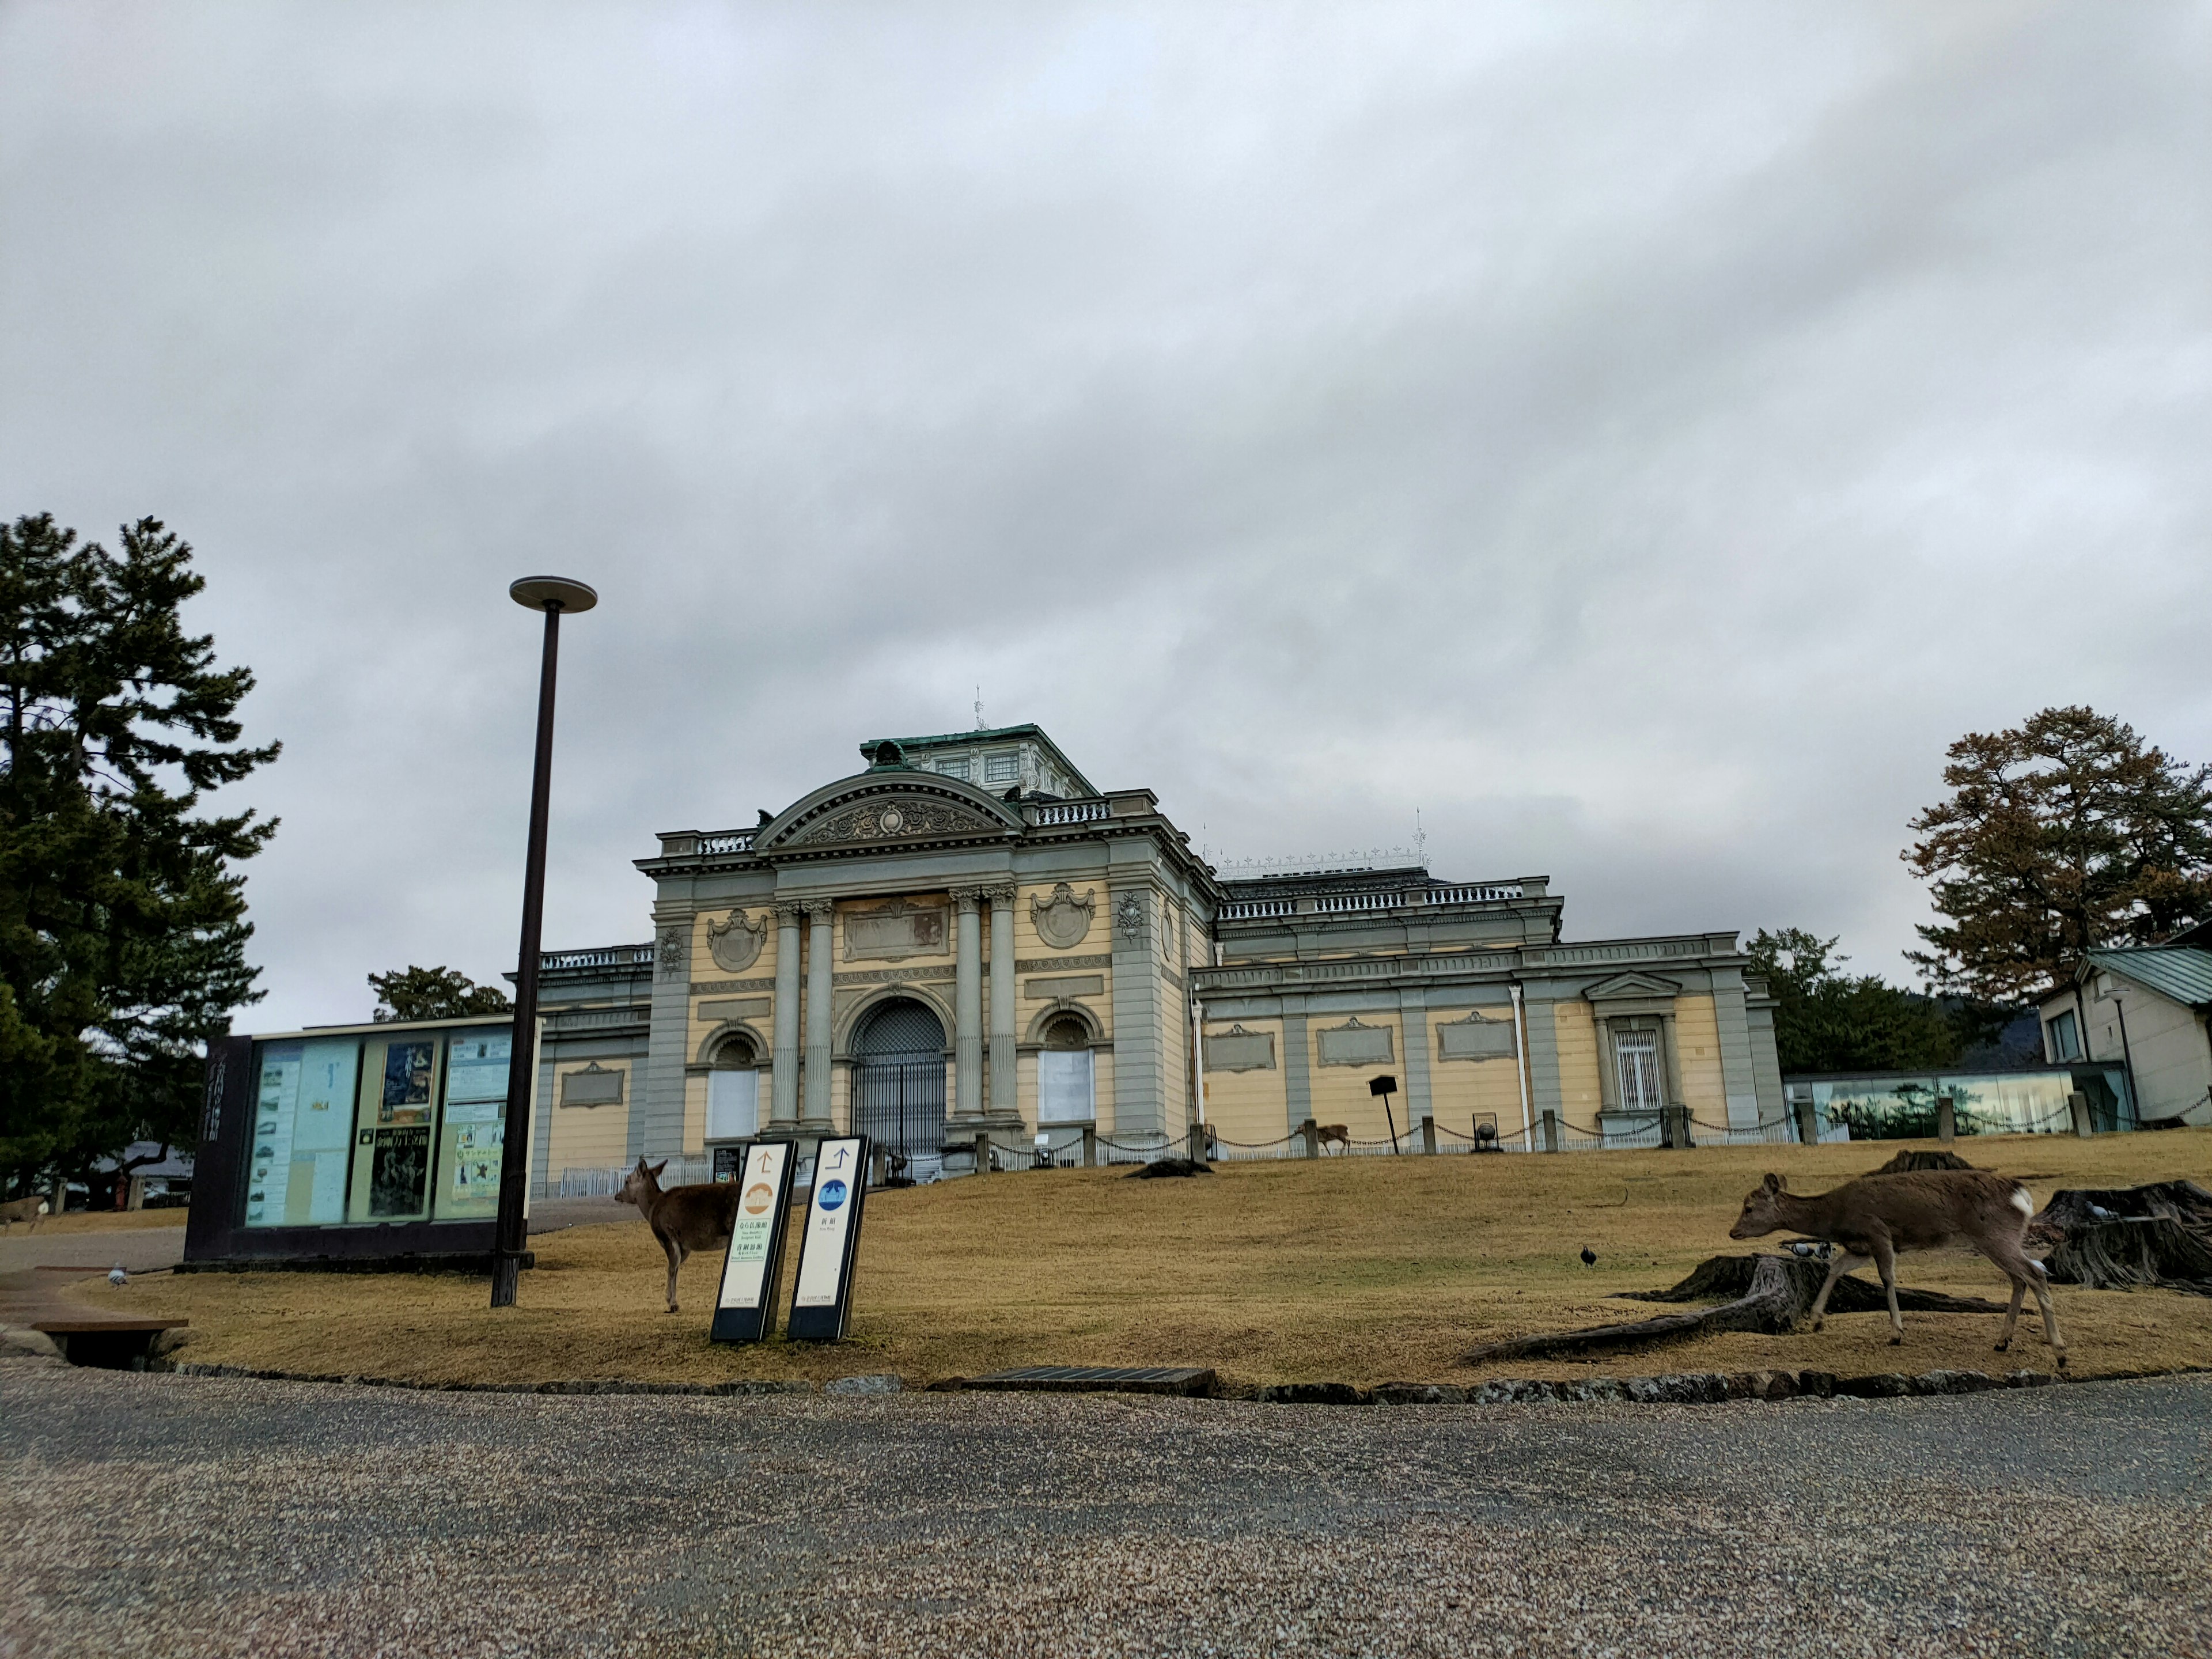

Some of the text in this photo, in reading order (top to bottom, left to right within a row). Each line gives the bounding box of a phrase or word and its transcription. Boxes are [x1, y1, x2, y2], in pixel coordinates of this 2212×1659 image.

[740, 1221, 767, 1229] なら仏像館
[821, 1217, 836, 1225] 新館
